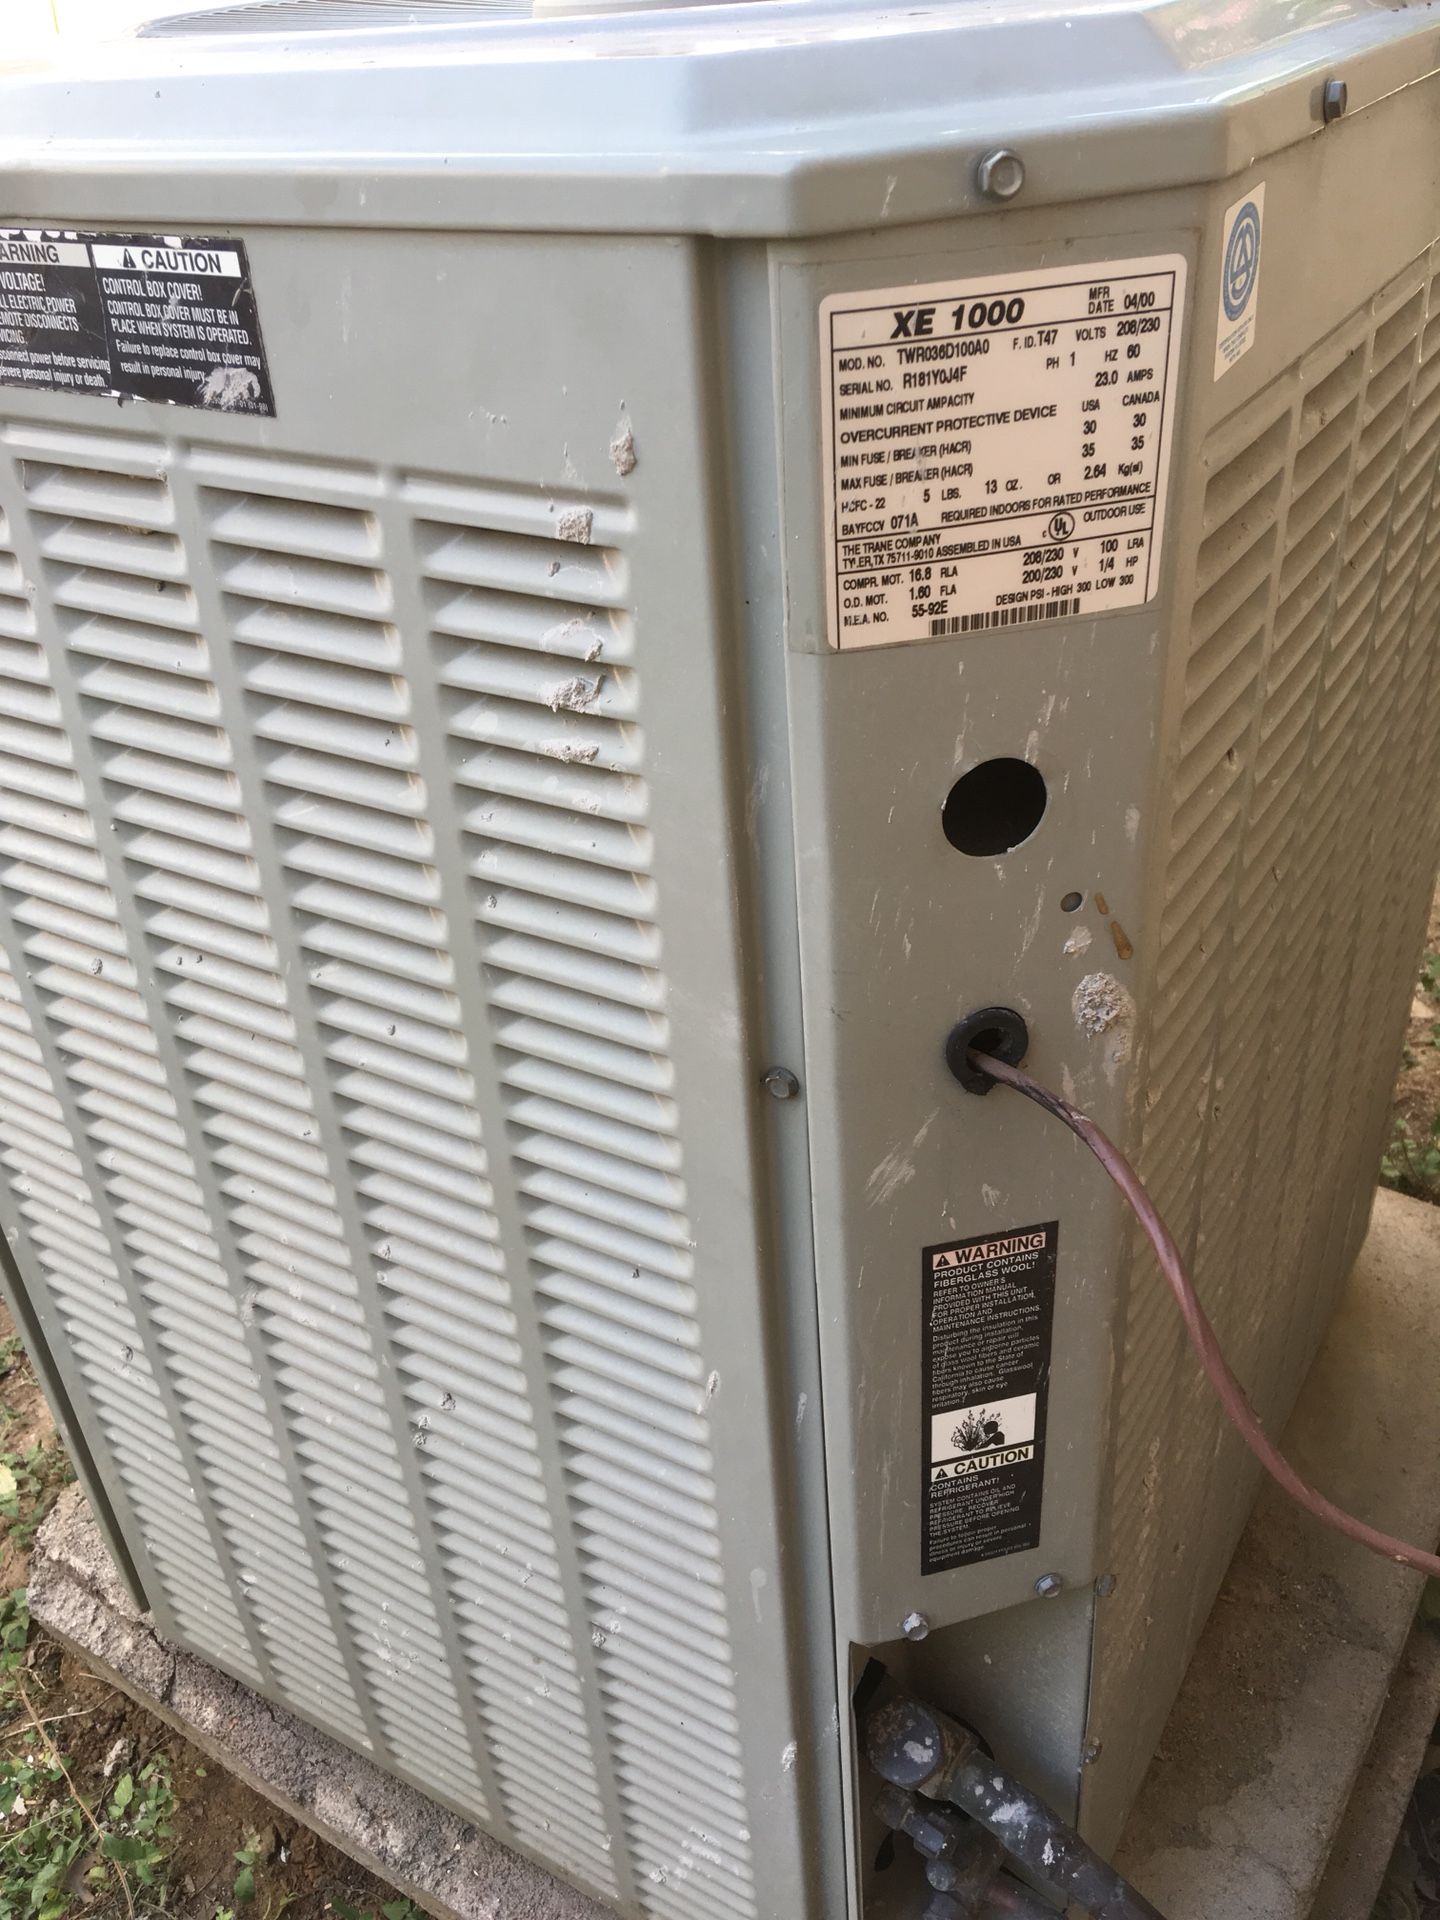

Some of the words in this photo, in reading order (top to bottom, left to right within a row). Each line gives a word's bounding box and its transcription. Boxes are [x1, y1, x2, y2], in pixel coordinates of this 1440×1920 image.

[140, 249, 222, 273] CAUTION
[0, 270, 46, 292] VOLTAGE!
[102, 276, 146, 297] CONTROL
[146, 280, 167, 298] BOX
[166, 282, 203, 301] COVER!
[1088, 286, 1110, 300] MFR
[8, 293, 45, 311] ELECTRIC
[45, 296, 76, 313] POWER
[106, 300, 145, 317] CONTROL
[145, 303, 163, 319] BOX
[162, 304, 191, 321] COVER
[191, 307, 216, 323] MUST
[216, 309, 229, 324] BE
[228, 310, 239, 325] IN
[1087, 299, 1114, 314] DATE
[1122, 290, 1155, 310] 04/00
[25, 313, 79, 331] DISCONNECTS
[890, 307, 935, 339] XE
[951, 296, 1025, 331] 1000
[111, 318, 137, 334] PLACE
[136, 320, 162, 336] WHEN
[161, 322, 196, 339] SYSTEM
[195, 325, 206, 340] IS
[205, 326, 252, 345] OPERATED.
[838, 357, 864, 372] MOD.
[867, 354, 885, 368] NO.
[897, 338, 989, 365] TWR036D100A0
[1037, 329, 1057, 347] T47
[1075, 325, 1106, 341] VOLTS
[1116, 316, 1161, 336] 208/230
[30, 353, 52, 366] power
[52, 352, 76, 367] before
[77, 356, 110, 373] servicing
[115, 338, 142, 355] Failure
[142, 341, 150, 355] to
[150, 342, 179, 362] replace
[178, 345, 207, 362] control
[206, 348, 221, 363] box
[221, 352, 244, 366] cover
[243, 355, 262, 370] may
[22, 365, 53, 384] personal
[53, 370, 74, 386] injury
[75, 374, 83, 384] or
[83, 372, 108, 387] death.
[120, 360, 141, 374] result
[141, 363, 150, 375] in
[150, 362, 182, 380] personal
[839, 380, 873, 397] SERIAL
[876, 378, 893, 392] NO.
[1046, 356, 1059, 370] PH
[1069, 352, 1076, 367] 1
[1104, 349, 1118, 362] HZ
[1126, 343, 1141, 359] 60
[839, 403, 883, 421] MINIMUM
[885, 398, 924, 415] CIRCUIT
[926, 392, 974, 410] AMPACITY
[1095, 370, 1118, 387] 23.0
[1126, 368, 1153, 383] AMPS
[840, 421, 933, 445] OVERCURRENT
[936, 411, 1010, 432] PROTECTIVE
[1013, 404, 1057, 422] DEVICE
[1081, 398, 1100, 413] USA
[1122, 390, 1160, 407] CANADA
[840, 454, 858, 468] MIN
[861, 450, 885, 465] FUSE
[939, 439, 971, 457] (HACR)
[1082, 419, 1097, 435] 30
[1132, 413, 1146, 428] 30
[840, 477, 861, 491] MAX
[863, 474, 887, 488] FUSE
[941, 462, 973, 481] (HACR)
[1081, 442, 1095, 458] 35
[1130, 435, 1144, 451] 35
[874, 496, 885, 509] 22
[923, 488, 930, 502] 5
[941, 487, 961, 501] LBS.
[985, 479, 997, 494] 13
[1047, 472, 1061, 485] OR
[1083, 464, 1106, 480] 2.64
[890, 512, 918, 529] 071A
[941, 505, 987, 522] REQUIRED
[989, 499, 1031, 515] INDOORS
[1032, 496, 1052, 509] FOR
[1052, 492, 1082, 506] RATED
[1084, 481, 1151, 501] PERFORMANCE
[1083, 505, 1126, 522] OUTDOOR
[1128, 502, 1146, 515] USE
[842, 543, 861, 557] THE
[863, 539, 892, 554] TRANE
[895, 532, 941, 550] COMPANY
[886, 547, 933, 564] 75711-9010
[935, 539, 989, 557] ASSEMBLED
[991, 537, 1000, 549] IN
[1002, 534, 1021, 547] USA
[843, 575, 878, 591] COMPR.
[881, 572, 903, 586] MOT.
[909, 566, 931, 582] 16.8
[940, 565, 958, 578] RLA
[1022, 546, 1064, 566] 208/230
[1072, 546, 1078, 558] V
[1099, 538, 1118, 553] 100
[1126, 536, 1144, 549] LRA
[843, 596, 862, 609] O.D.
[865, 592, 887, 606] MOT.
[909, 584, 930, 600] 1.60
[939, 584, 956, 596] FLA
[1022, 565, 1063, 584] 200/230
[1071, 565, 1077, 576] V
[1098, 556, 1115, 572] 1/4
[1125, 555, 1138, 567] HP
[872, 610, 888, 623] NO.
[911, 599, 948, 618] 55-92E
[995, 590, 1028, 606] DESIGN
[1030, 588, 1044, 600] PSI
[1051, 583, 1073, 597] HIGH
[1076, 580, 1091, 593] 300
[1095, 577, 1115, 590] LOW
[1119, 574, 1134, 586] 300
[954, 1233, 1043, 1264] WARNING
[933, 1262, 982, 1280] PRODUCT
[986, 1251, 1038, 1269] CONTAINS
[933, 1268, 998, 1289] FIBERGLASS
[1001, 1260, 1035, 1275] WOOL!
[932, 1288, 984, 1305] INFORMATION
[985, 1281, 1016, 1294] MANUAL
[933, 1286, 957, 1298] REFER
[959, 1284, 969, 1292] TO
[933, 1298, 970, 1312] PROVIDED
[971, 1293, 991, 1304] WITH
[992, 1290, 1008, 1299] THIS
[1010, 1286, 1027, 1296] UNIT
[932, 1311, 975, 1326] OPERATION
[976, 1307, 992, 1316] AND
[950, 1303, 980, 1315] PROPER
[932, 1316, 985, 1333] MAINTENANCE
[953, 1446, 1028, 1475] CAUTION
[930, 1474, 978, 1491] CONTAINS
